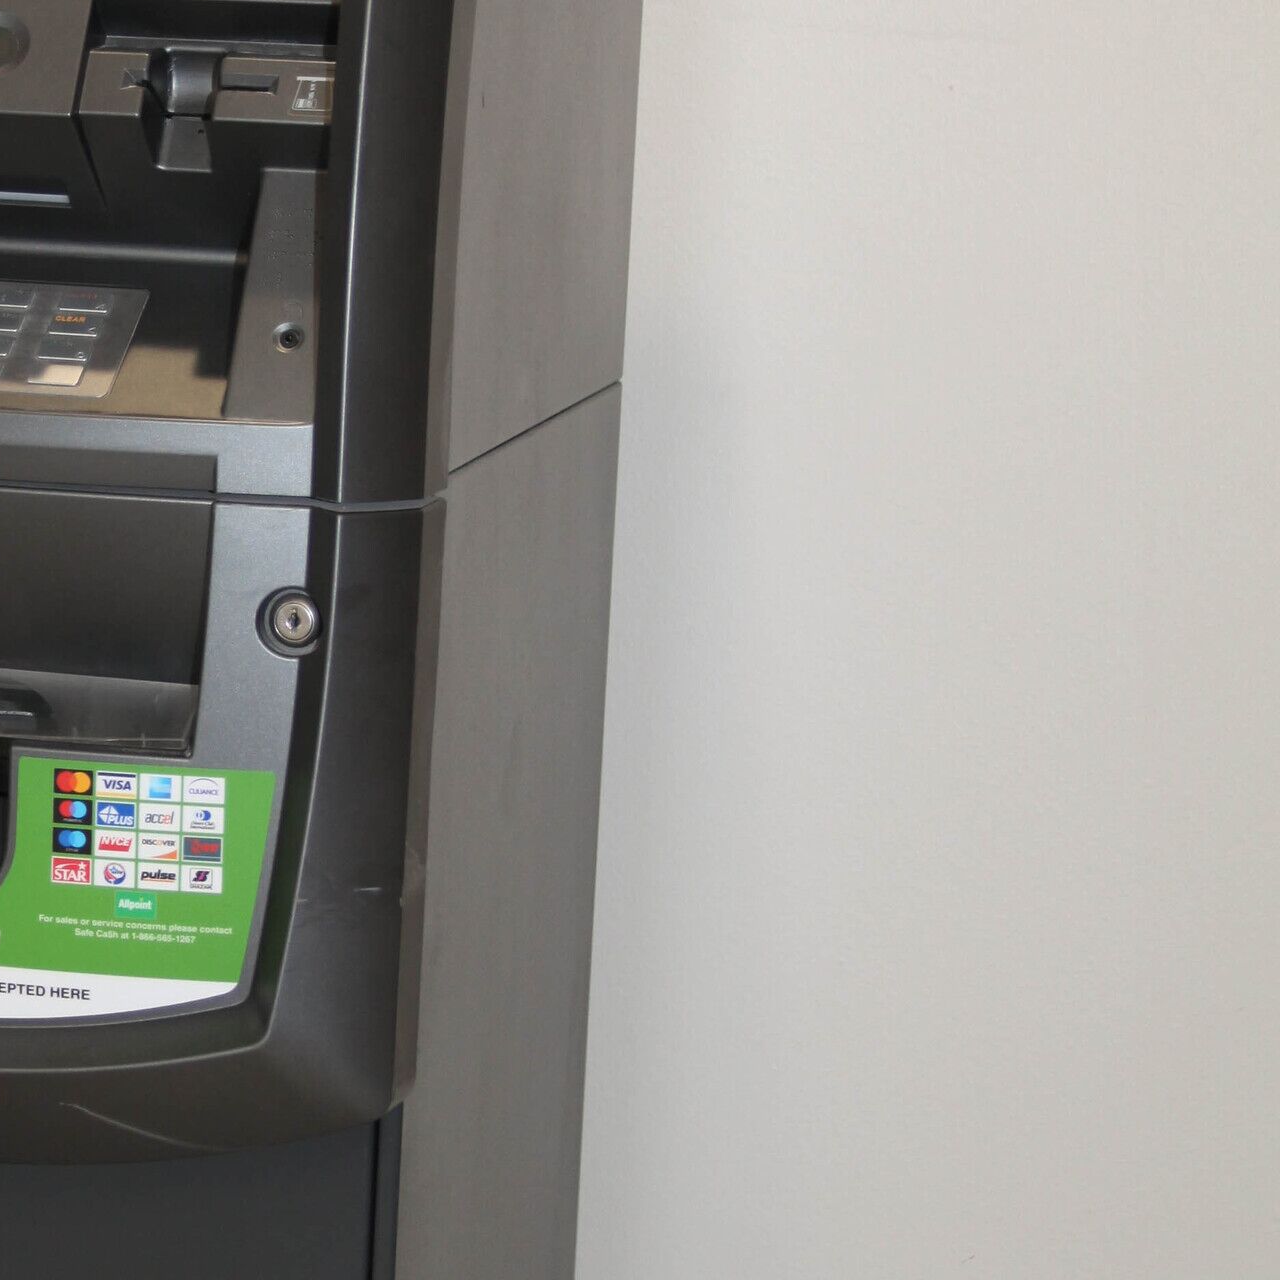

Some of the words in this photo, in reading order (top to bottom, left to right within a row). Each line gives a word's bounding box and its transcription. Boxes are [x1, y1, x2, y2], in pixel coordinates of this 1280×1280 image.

[55, 315, 87, 324] CLEAR
[103, 779, 132, 791] VISA
[107, 815, 134, 826] PLUS
[144, 811, 174, 825] accel
[101, 835, 131, 847] NYCE
[142, 839, 176, 847] DISCOVER
[54, 868, 87, 882] STAR
[141, 869, 176, 880] pulse
[118, 896, 152, 911] Allpoint
[38, 913, 53, 922] For
[55, 916, 78, 925] sales
[92, 918, 123, 928] service
[168, 924, 197, 933] please
[200, 926, 232, 935] contact
[74, 927, 94, 937] Safe
[50, 986, 91, 1001] HERE
